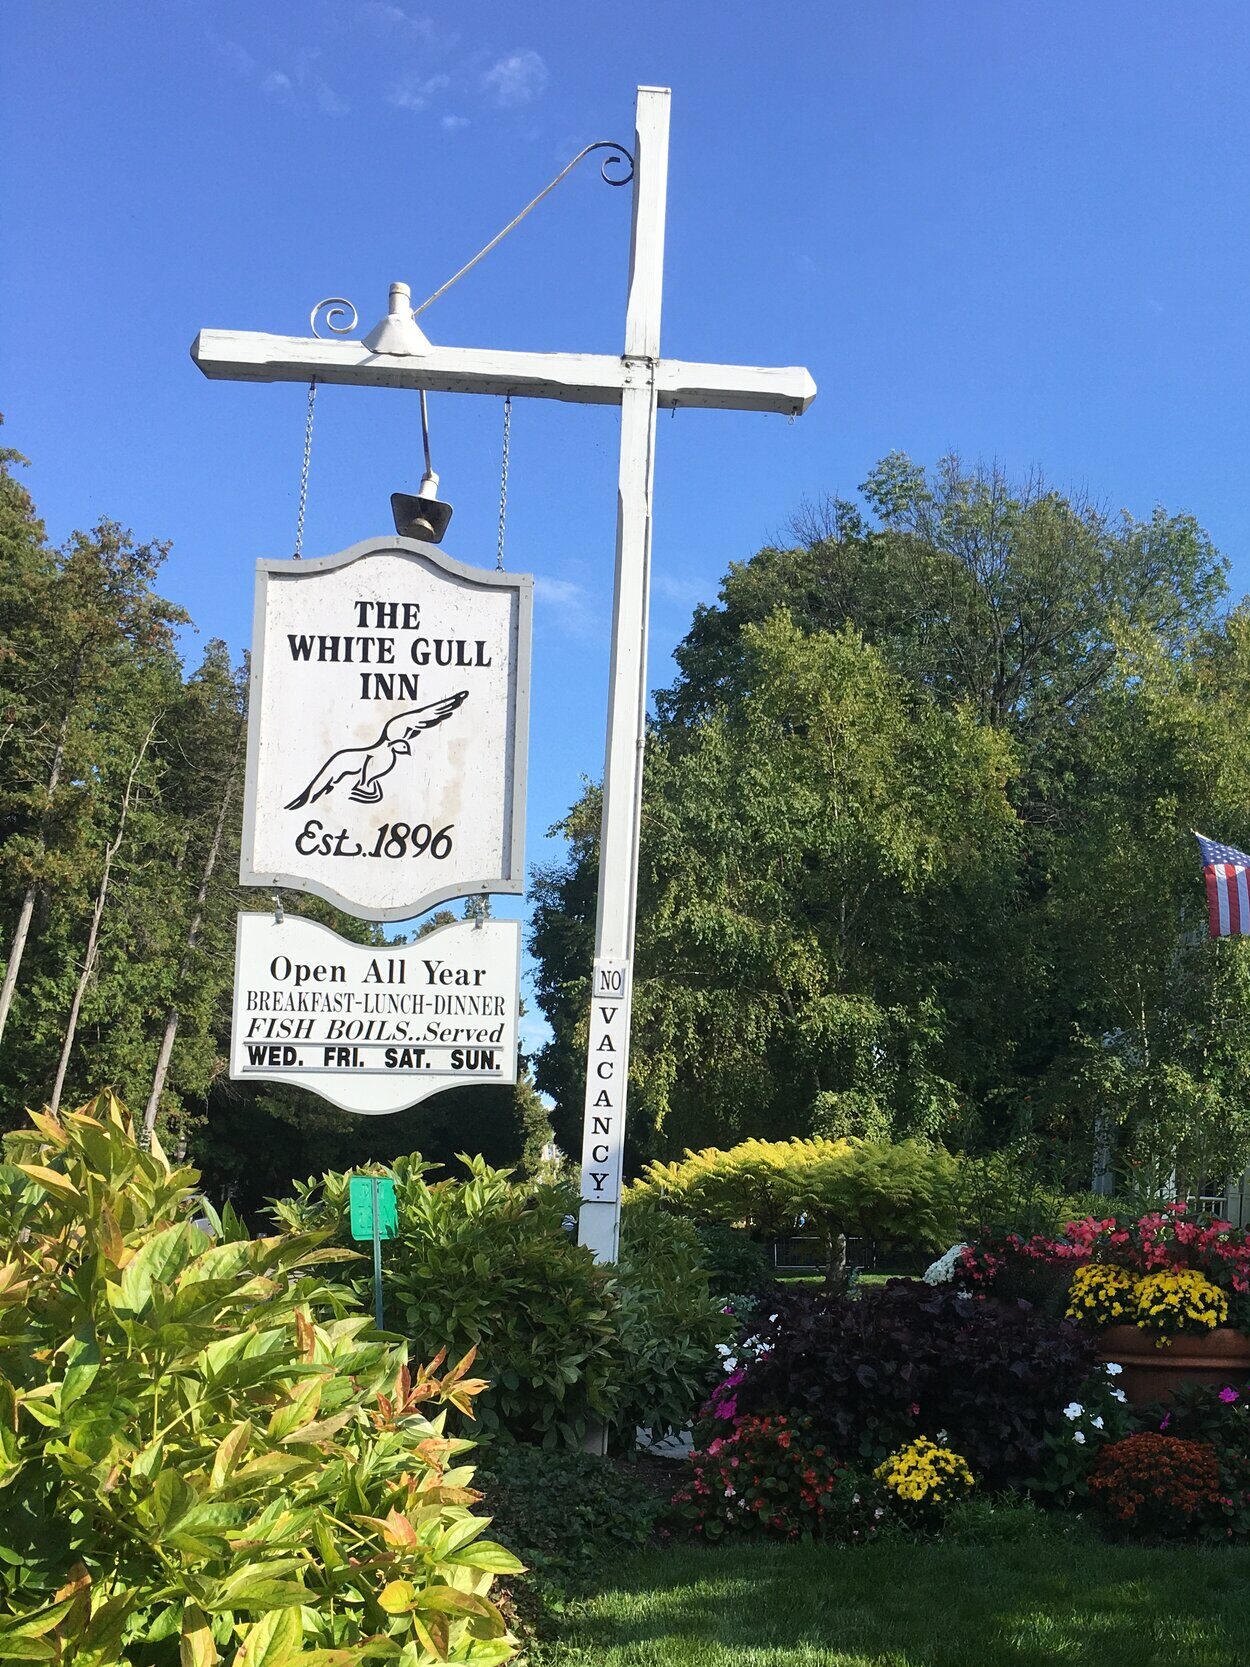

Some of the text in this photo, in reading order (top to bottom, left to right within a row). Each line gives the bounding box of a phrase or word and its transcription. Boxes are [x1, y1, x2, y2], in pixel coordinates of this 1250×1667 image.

[354, 601, 421, 630] THE
[287, 634, 492, 667] WHITE GULL
[359, 672, 420, 701] INN
[270, 955, 486, 987] Open All Year
[600, 970, 621, 990] NO
[245, 1018, 316, 1039] FISH
[249, 1046, 501, 1070] WED. FRI. SAT. SUN.
[589, 1007, 618, 1191] VACANCY
